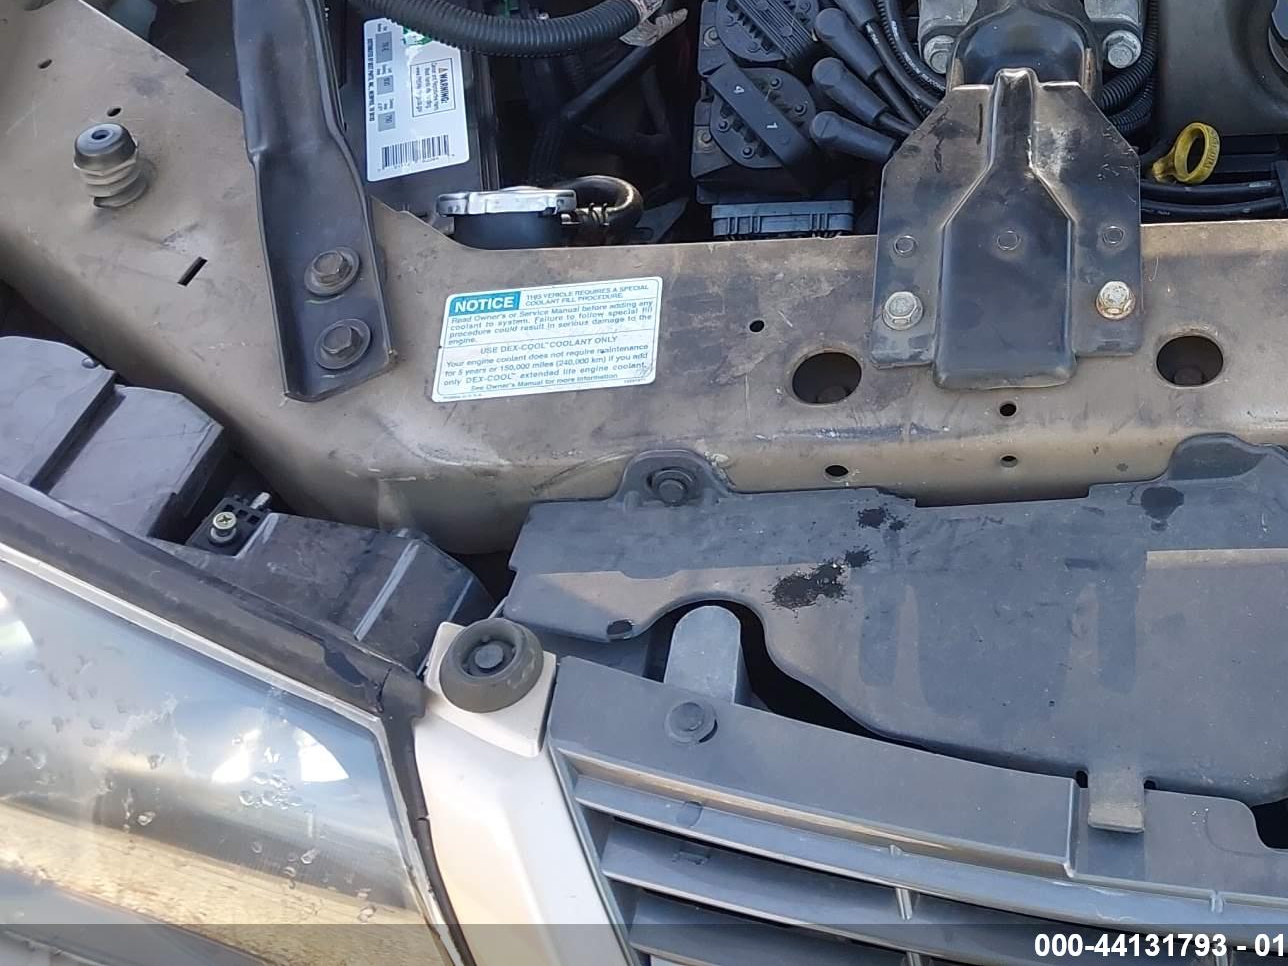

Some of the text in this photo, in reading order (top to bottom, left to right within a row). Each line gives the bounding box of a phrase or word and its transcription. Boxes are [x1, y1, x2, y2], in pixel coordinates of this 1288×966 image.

[439, 73, 448, 103] WARNING:
[733, 86, 745, 94] 4
[455, 298, 514, 313] NOTICE
[525, 299, 560, 307] COOLANT
[450, 323, 482, 331] coolant
[534, 315, 563, 324] Failure
[578, 311, 604, 319] follow
[608, 308, 638, 317] special
[451, 316, 472, 324] Read
[473, 314, 506, 322] Owner's
[519, 309, 549, 318] Service
[609, 302, 636, 311] adding
[449, 329, 491, 339] procedure
[494, 325, 518, 333] could
[520, 323, 545, 331] result
[558, 320, 589, 328] serious
[591, 317, 625, 326] damage
[481, 336, 617, 354] USE COOLANT ONLY
[464, 367, 487, 376] years
[500, 362, 530, 371] 150,000
[532, 360, 554, 368] miles
[556, 357, 589, 368] (240,000
[591, 356, 606, 364] km)
[615, 354, 630, 362] you
[632, 352, 648, 360] add
[467, 357, 494, 366] engine
[496, 354, 526, 363] coolant
[566, 348, 595, 357] require
[520, 369, 559, 378] extended
[563, 367, 577, 375] life
[580, 365, 609, 374] engine
[486, 381, 515, 390] Owner's
[518, 379, 544, 387] Manual
[577, 373, 618, 382] information
